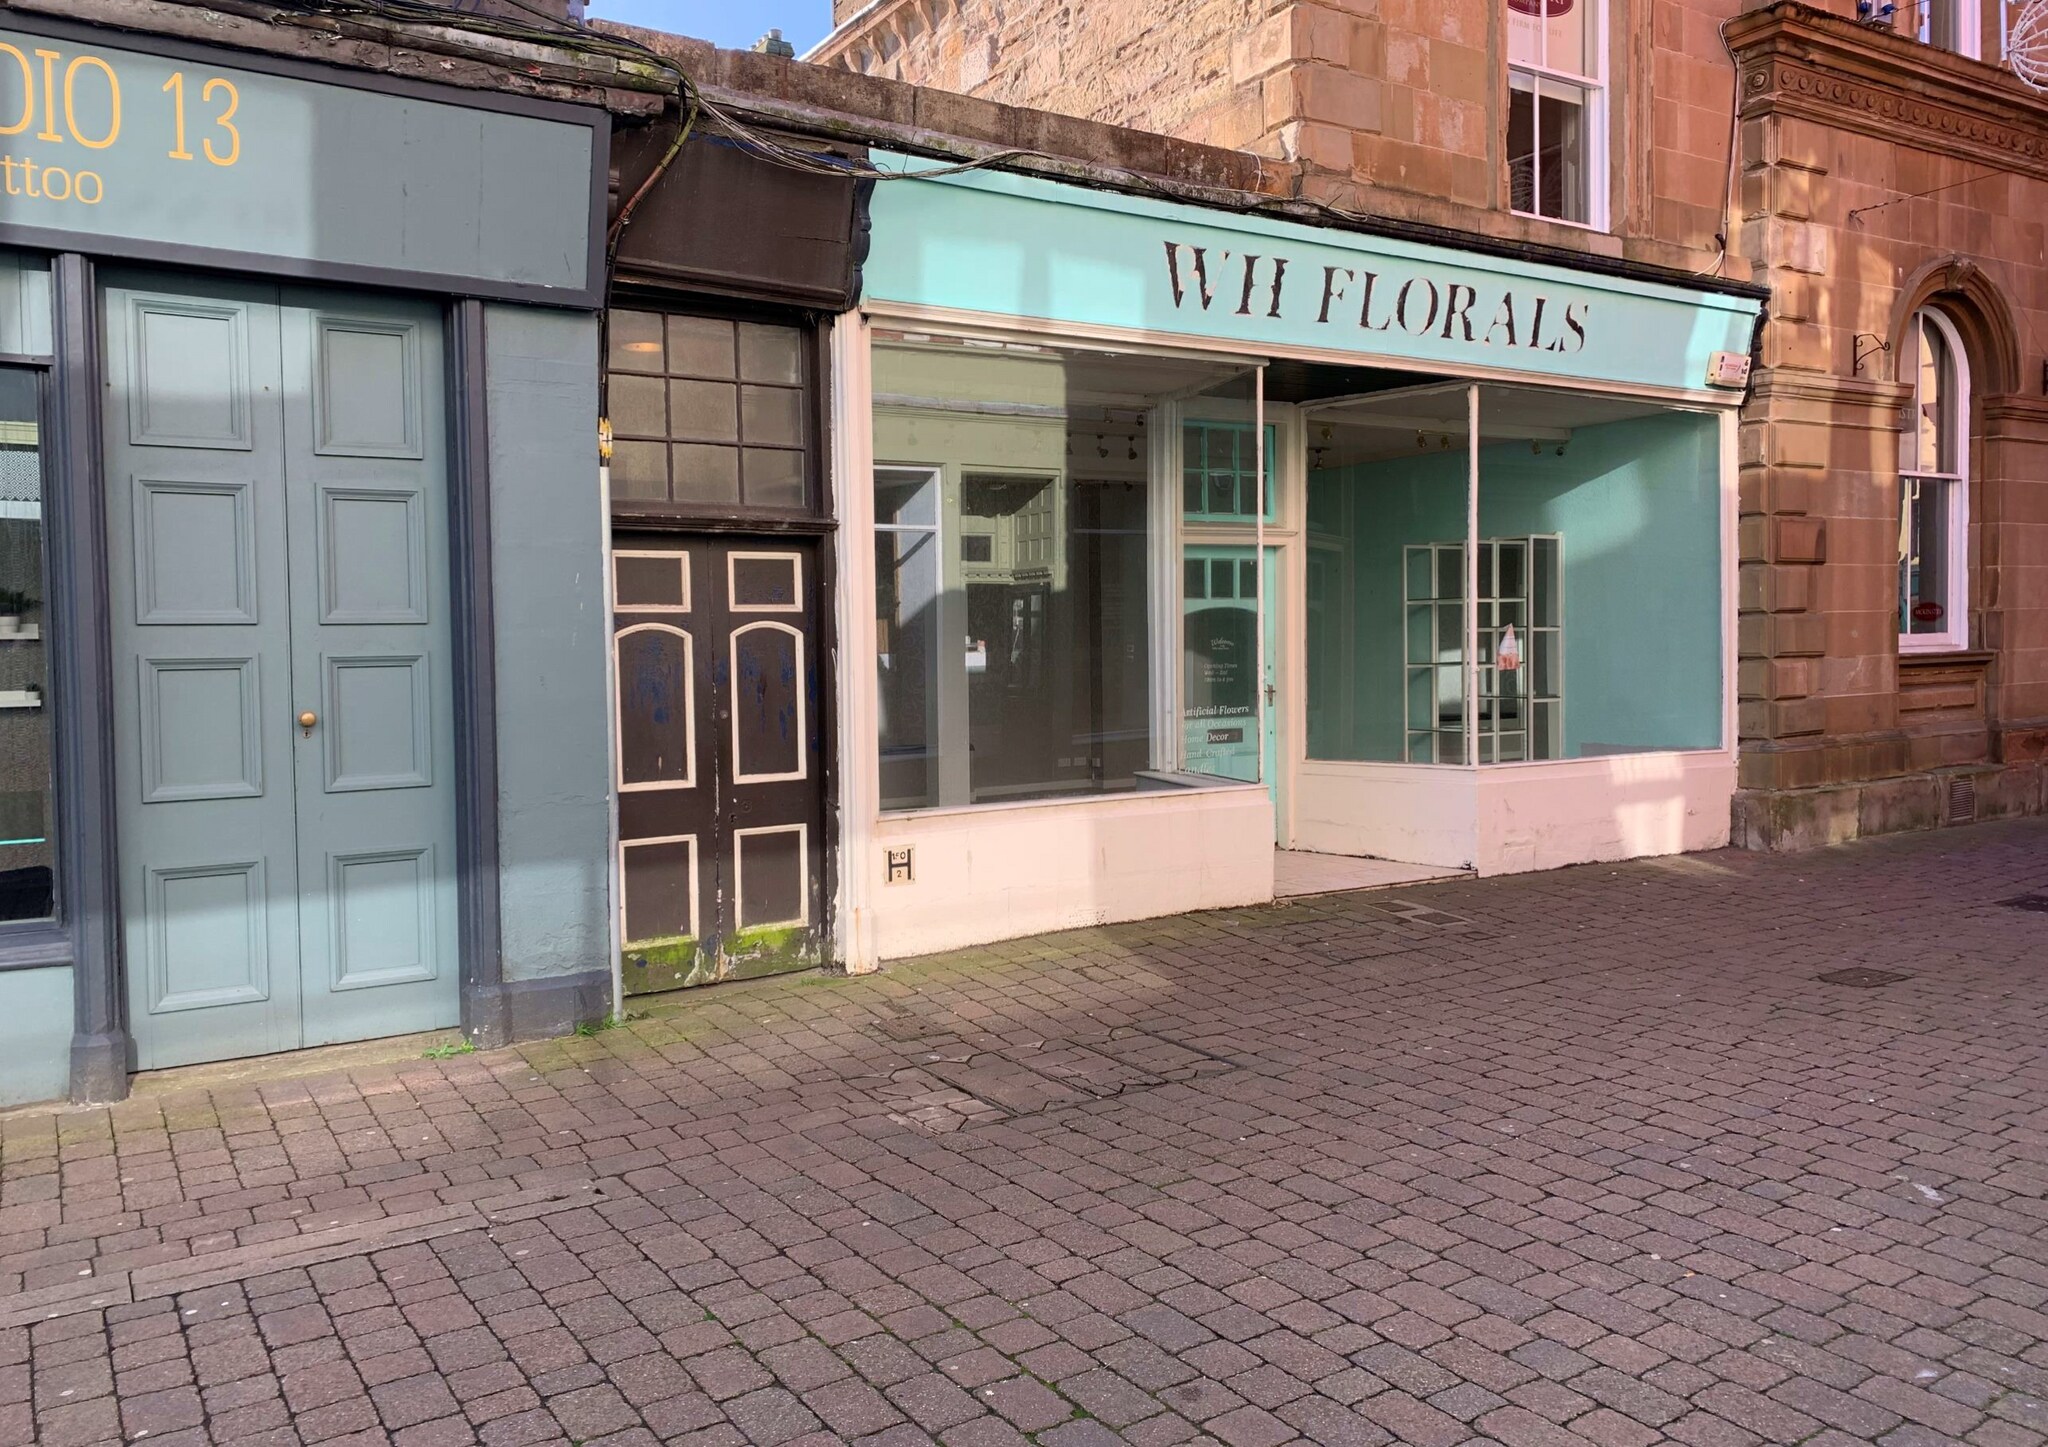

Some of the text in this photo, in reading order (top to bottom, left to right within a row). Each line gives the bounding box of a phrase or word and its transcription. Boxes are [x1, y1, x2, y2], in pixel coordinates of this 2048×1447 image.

[1532, 23, 1542, 32] FO
[0, 42, 240, 166] DIO 13
[1163, 241, 1590, 353] WH FLORALS
[1219, 704, 1250, 716] Flowers
[1207, 717, 1247, 729] Occasions
[1206, 733, 1229, 743] Decor
[1206, 745, 1236, 758] Crafted
[896, 870, 902, 878] 2
